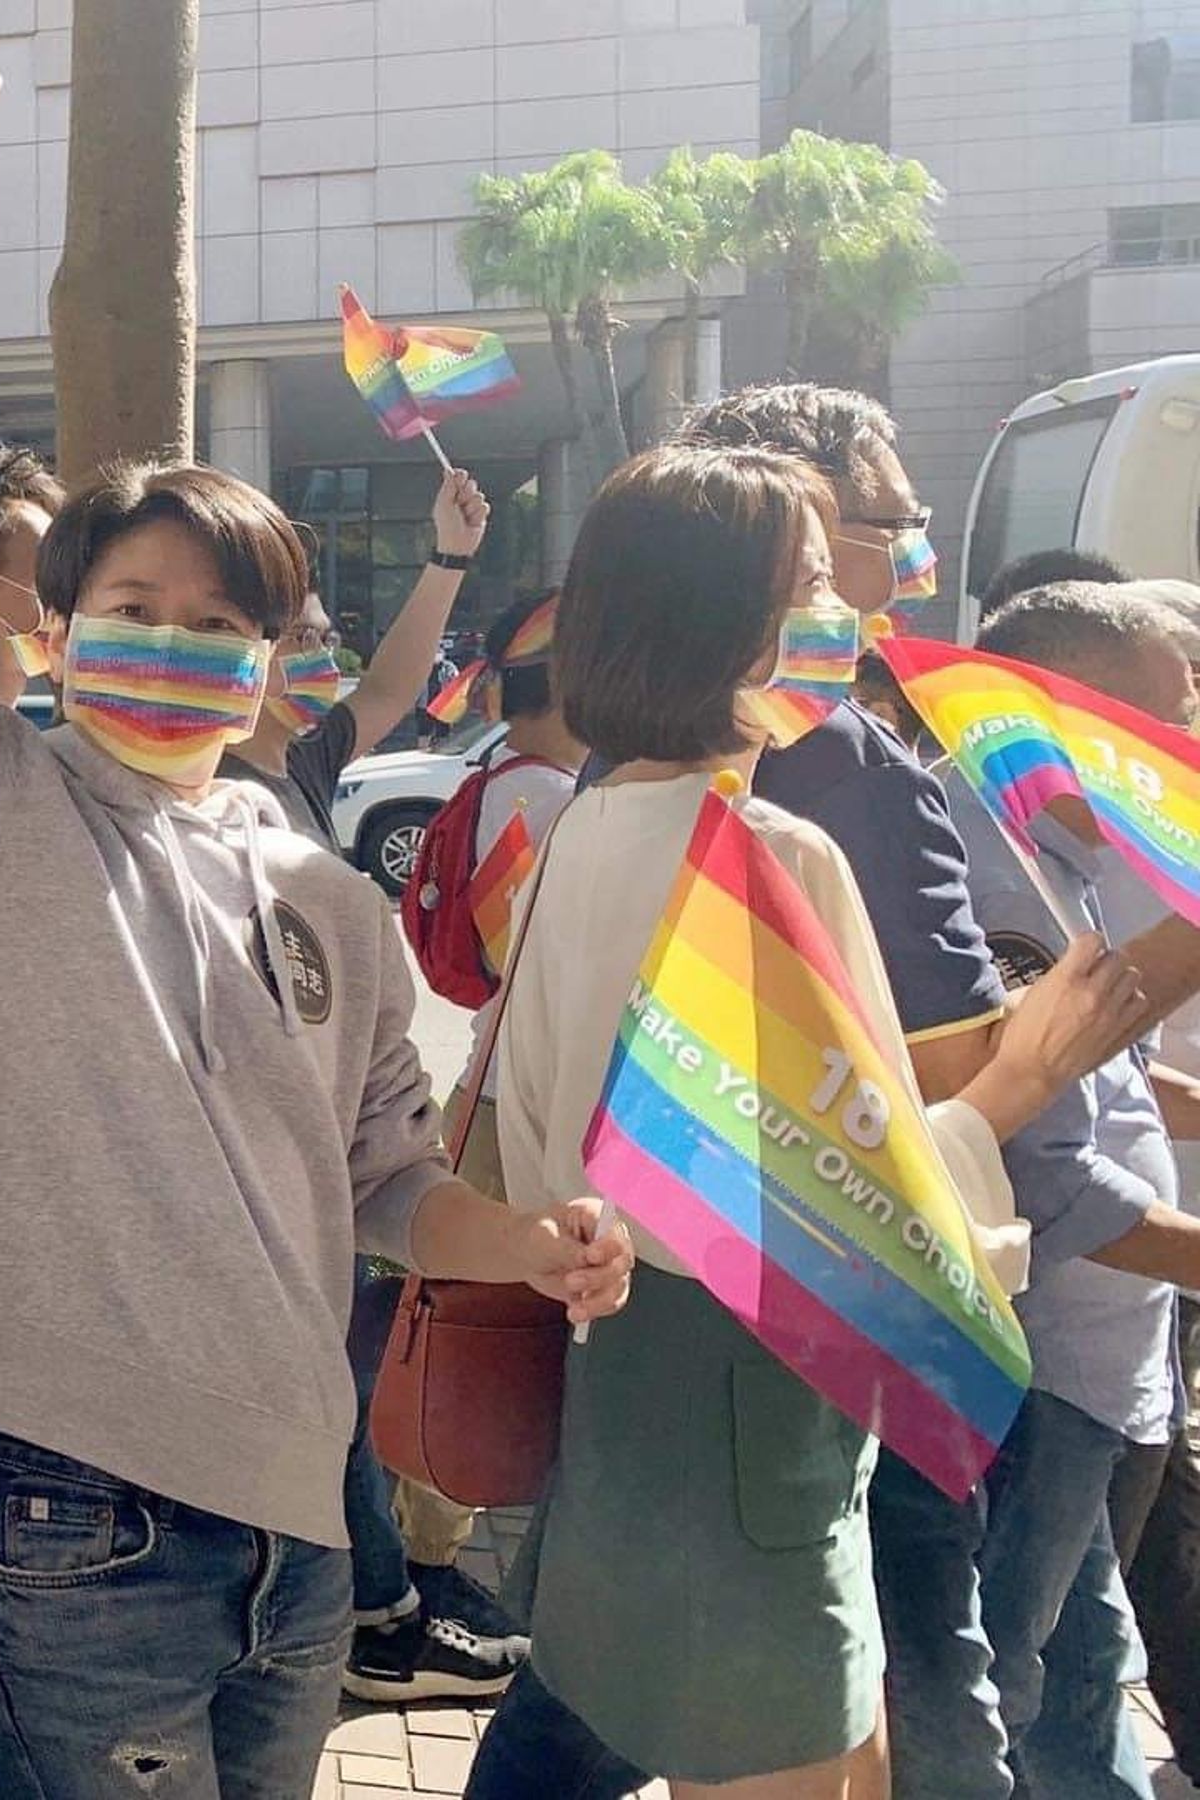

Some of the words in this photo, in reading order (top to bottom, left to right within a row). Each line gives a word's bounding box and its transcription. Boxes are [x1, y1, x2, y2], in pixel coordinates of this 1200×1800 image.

[627, 979, 704, 1074] Make
[713, 1061, 811, 1148] Your
[813, 1145, 896, 1226] Own
[901, 1215, 1004, 1336] Choice
[808, 1045, 891, 1150] 18
